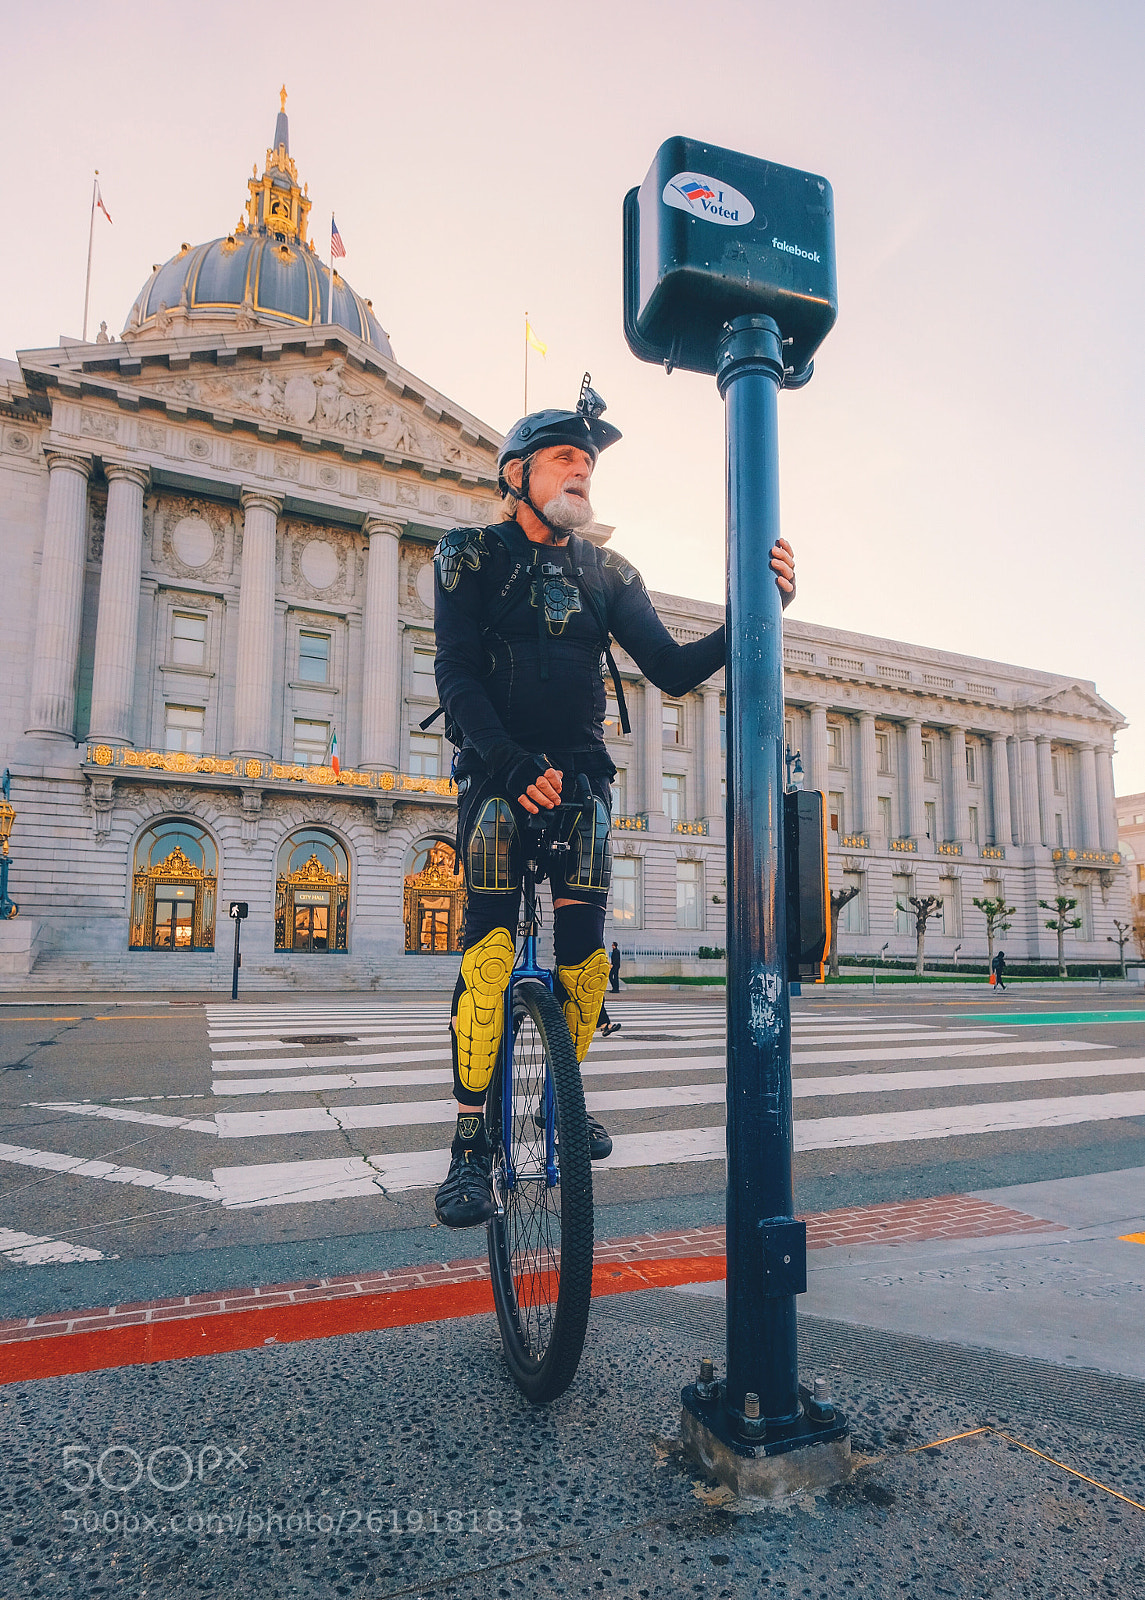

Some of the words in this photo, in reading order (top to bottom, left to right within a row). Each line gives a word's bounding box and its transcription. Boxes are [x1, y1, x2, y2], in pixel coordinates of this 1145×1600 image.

[717, 191, 724, 203] I
[700, 198, 739, 222] Voted
[771, 237, 821, 264] fakebook
